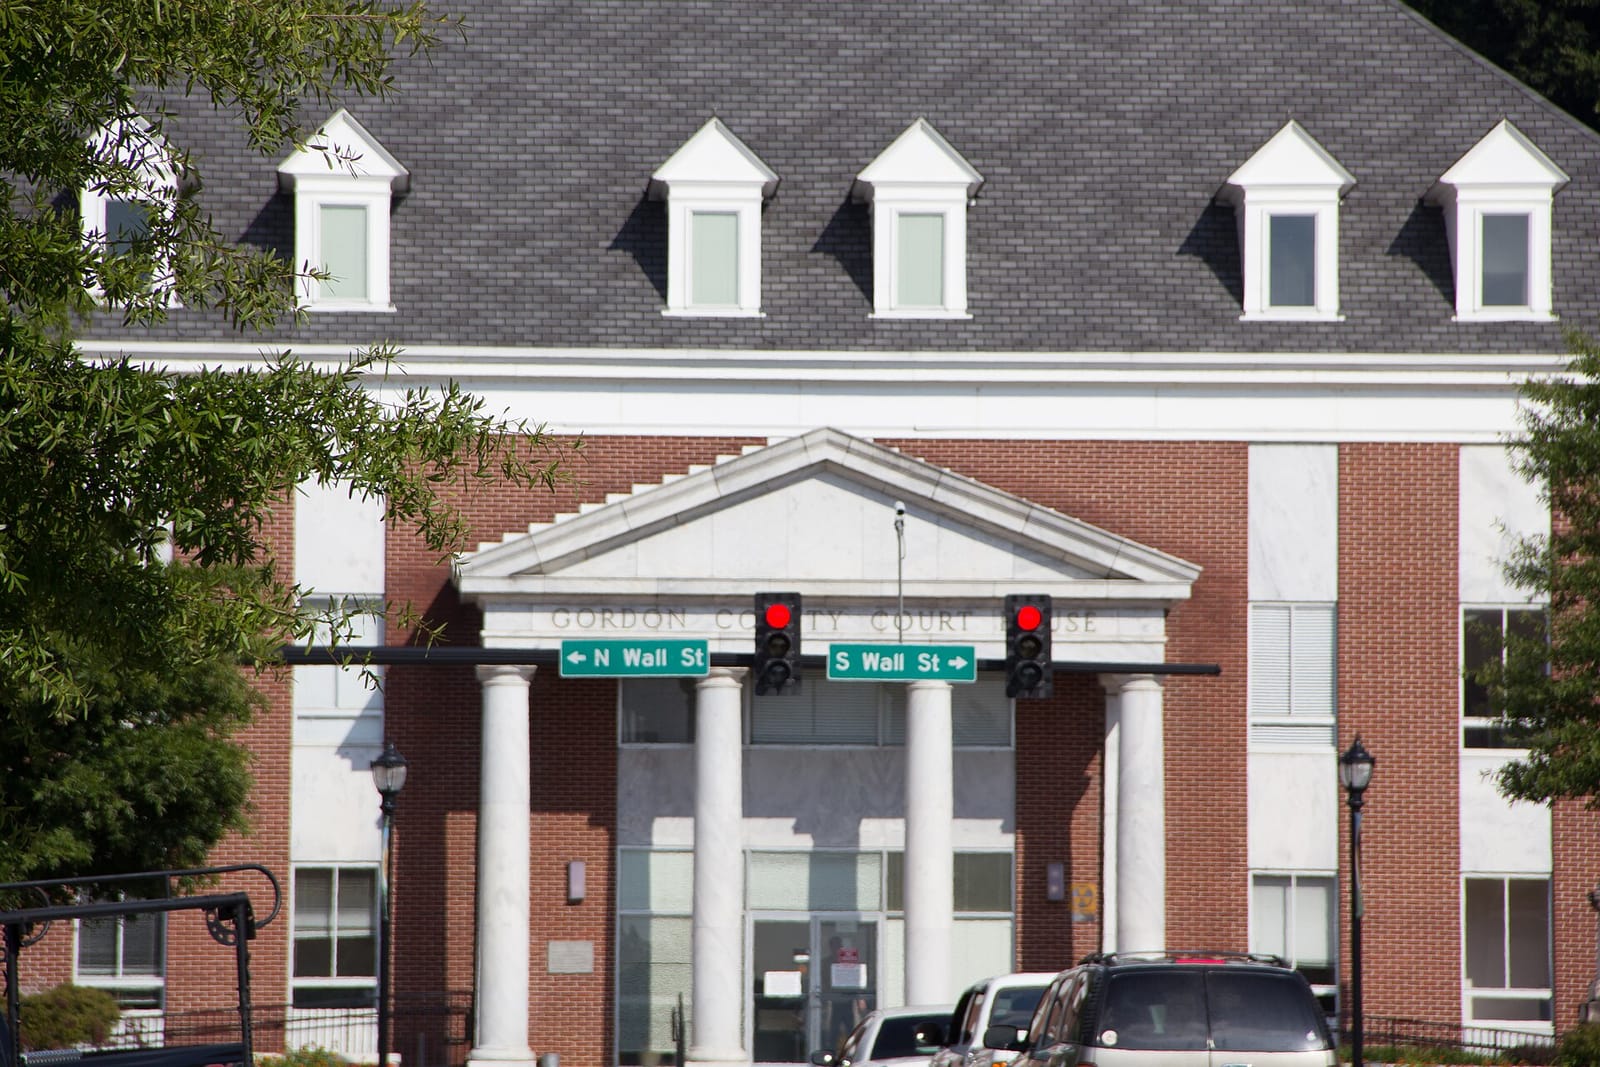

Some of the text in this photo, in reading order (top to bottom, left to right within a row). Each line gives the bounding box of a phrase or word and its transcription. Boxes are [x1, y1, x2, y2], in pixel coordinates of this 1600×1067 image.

[551, 607, 1097, 632] GORDON COTY COURT USE
[594, 648, 704, 667] N Wall St
[835, 651, 940, 673] S Wall St
